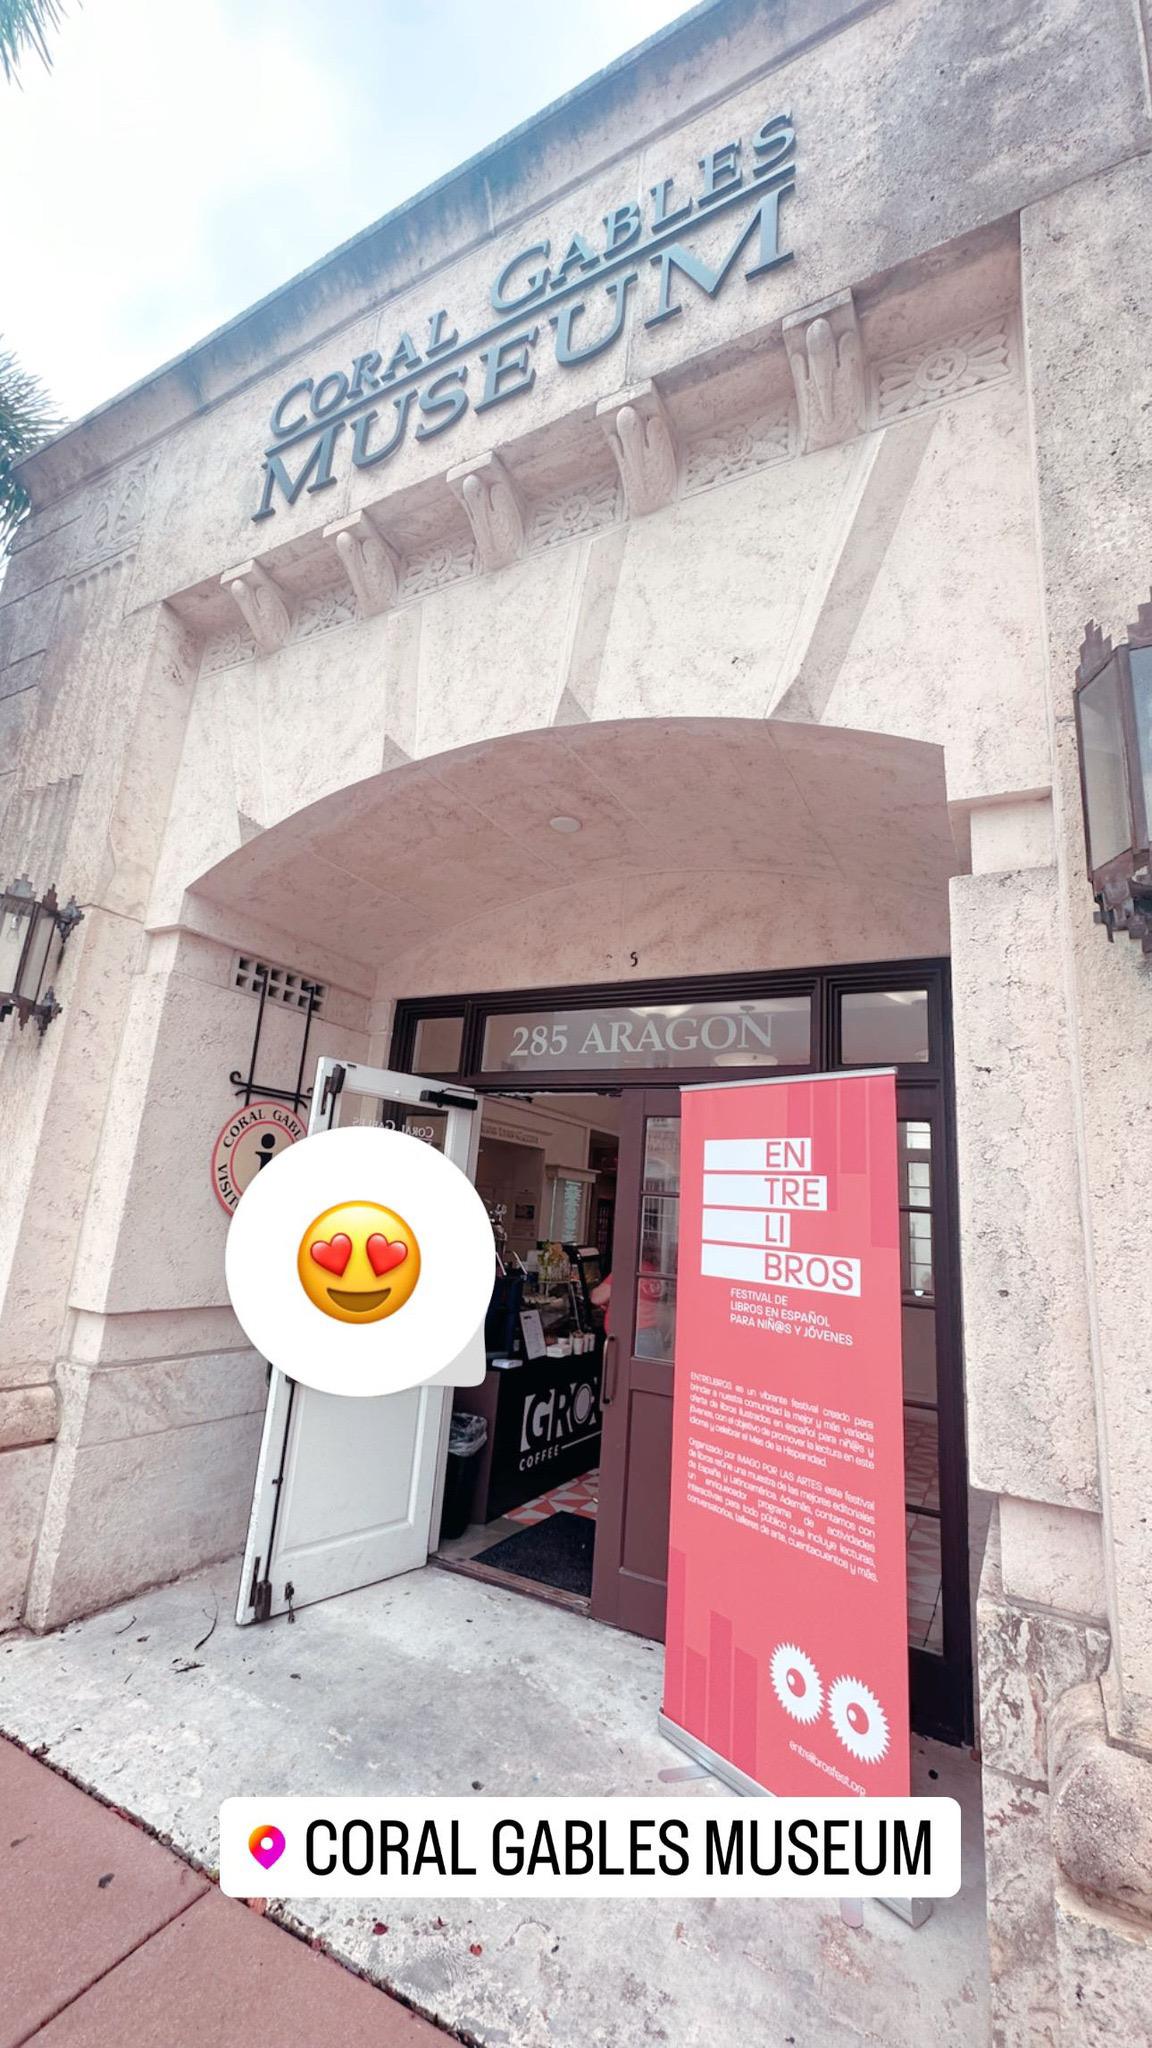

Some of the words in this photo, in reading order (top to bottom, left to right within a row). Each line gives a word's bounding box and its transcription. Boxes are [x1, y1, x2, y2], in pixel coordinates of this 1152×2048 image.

[269, 309, 461, 436] CORAL
[490, 110, 797, 313] GABLES
[250, 182, 795, 522] MUSEUM
[510, 1024, 568, 1056] 285
[580, 1015, 773, 1054] ARAGON
[223, 1109, 266, 1148] CORAL
[272, 1110, 302, 1140] GABL
[766, 1141, 806, 1168] EN
[218, 1164, 239, 1209] VISIT
[764, 1178, 820, 1207] TRE
[765, 1215, 785, 1244] LI
[764, 1253, 854, 1291] BROS
[730, 1288, 772, 1303] FESTIVAL
[774, 1296, 788, 1306] DE
[730, 1301, 763, 1314] LIBROS
[765, 1307, 779, 1318] EN
[781, 1310, 830, 1327] ESPAÑOL
[730, 1314, 755, 1327] PARA
[757, 1317, 792, 1334] NIÑ@S
[794, 1326, 802, 1335] Y
[804, 1327, 853, 1345] JÓVENES
[518, 1444, 560, 1472] COFFEE
